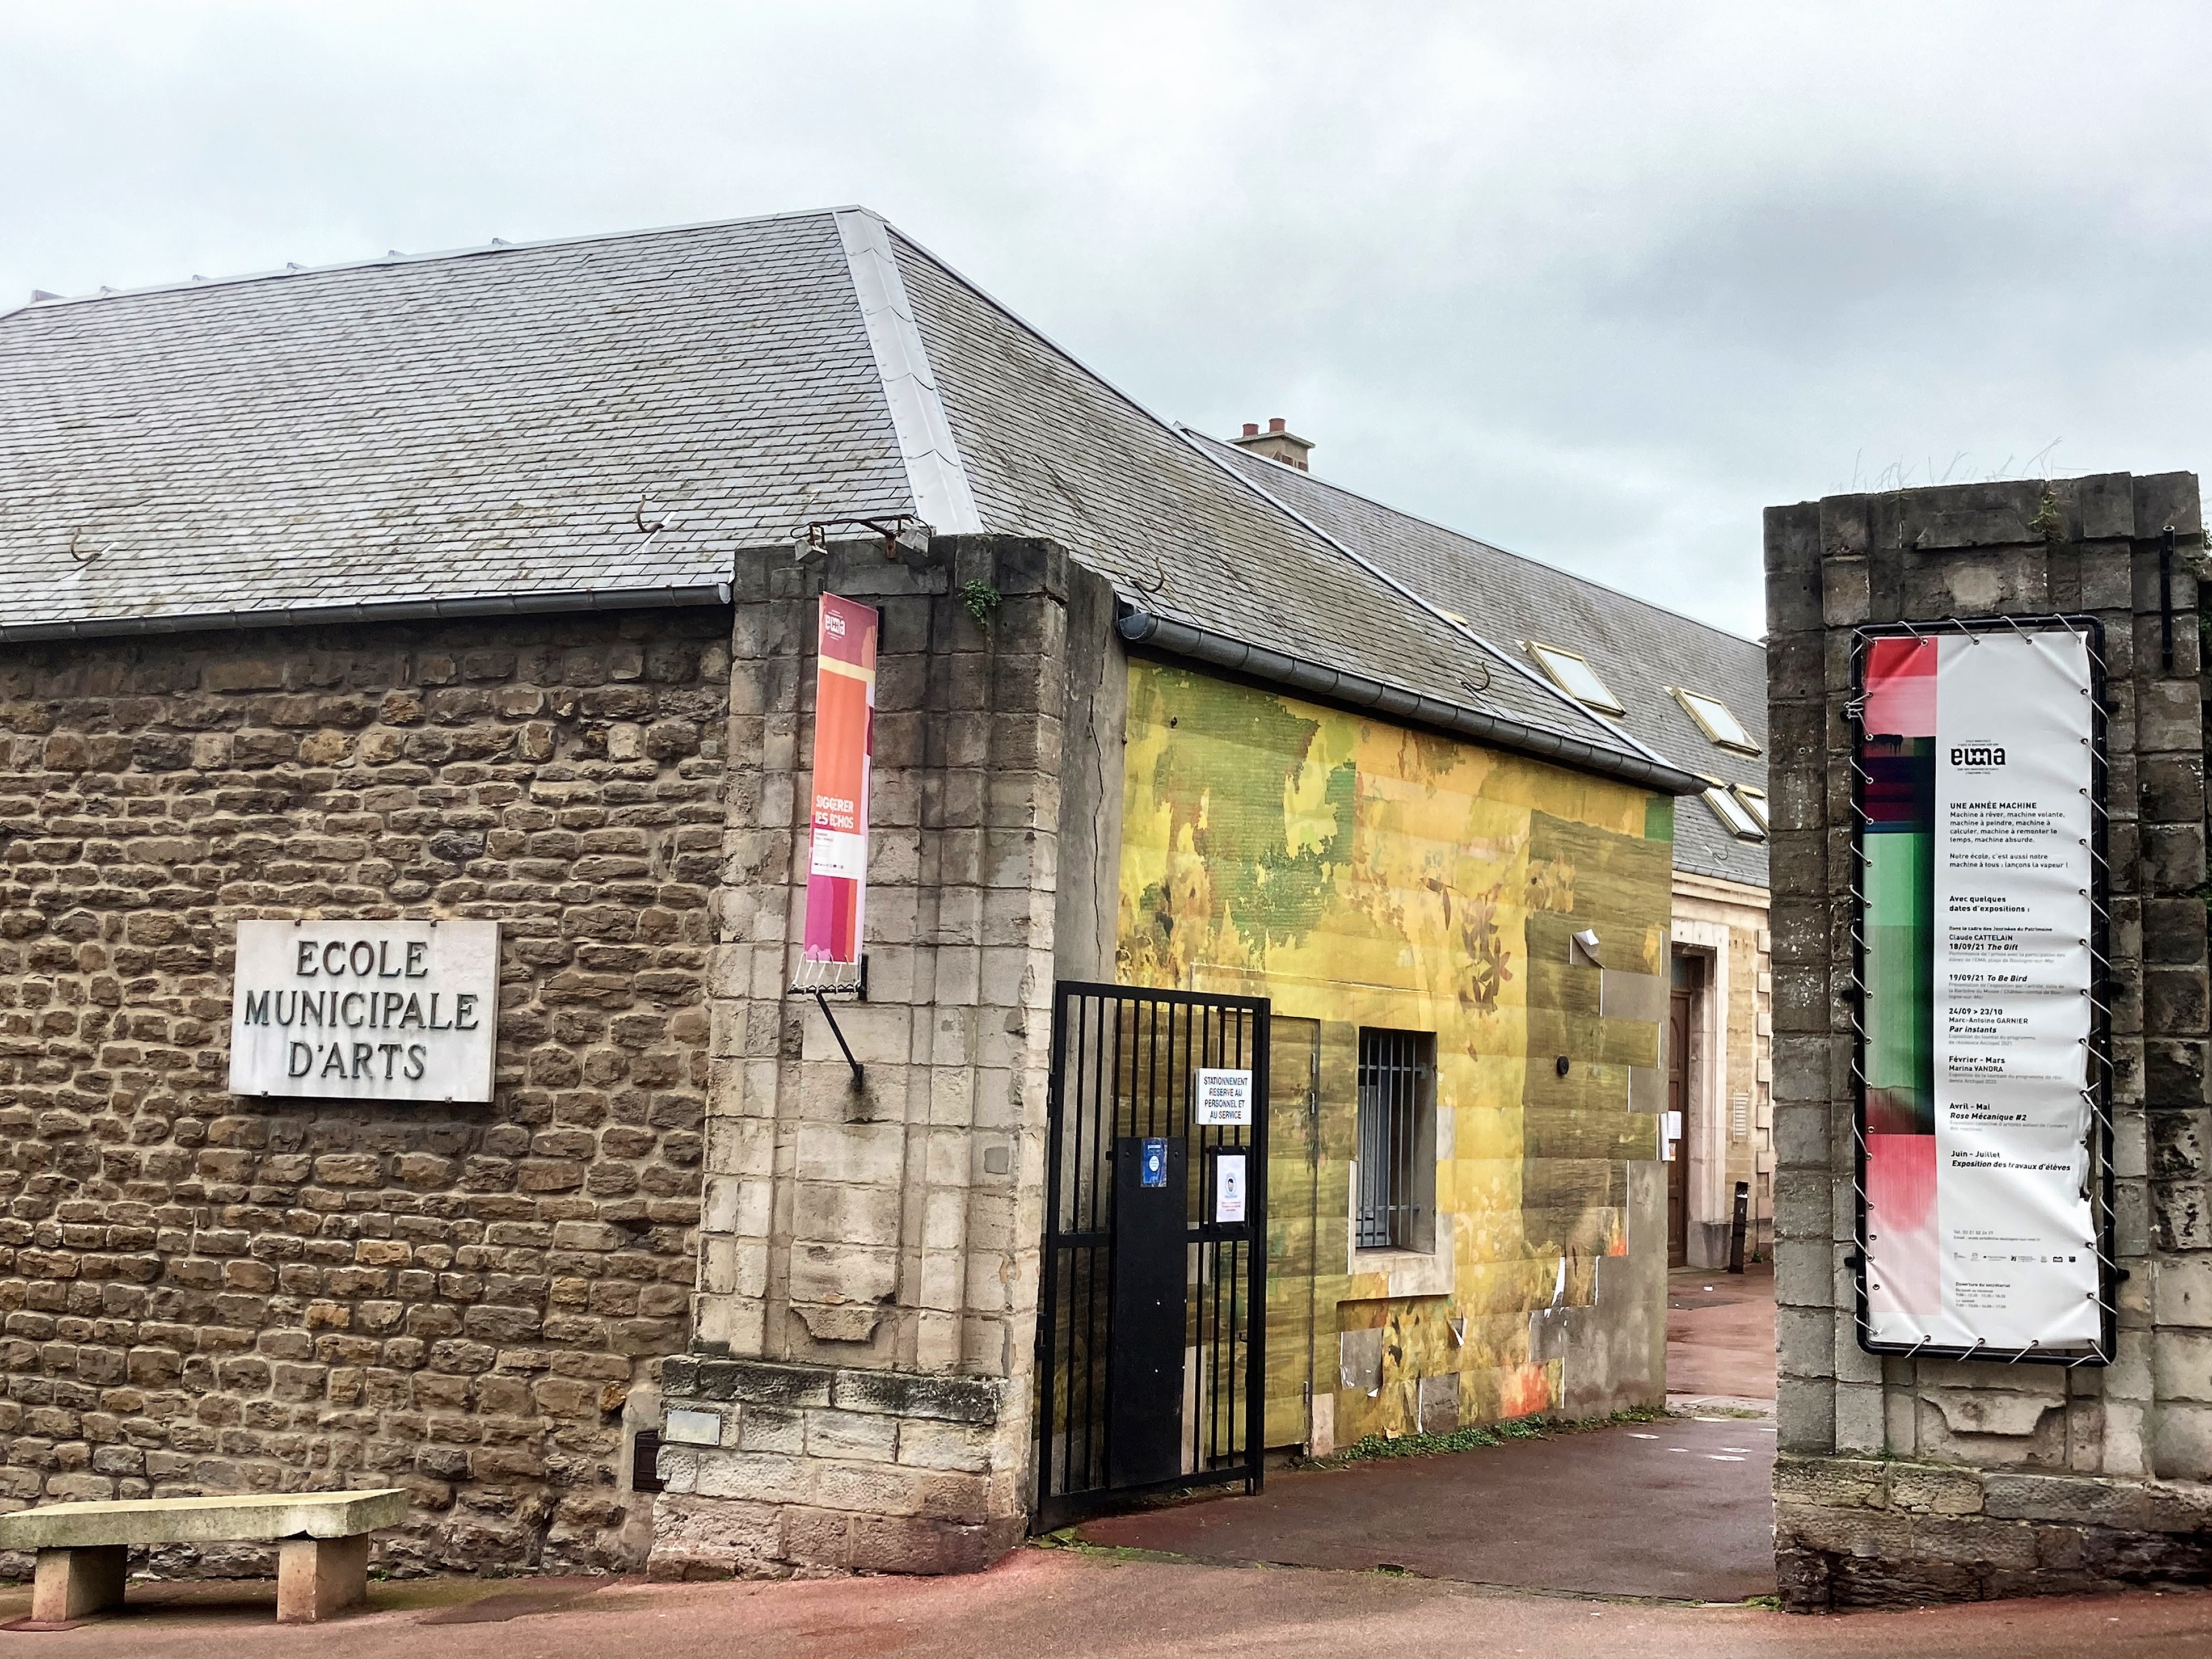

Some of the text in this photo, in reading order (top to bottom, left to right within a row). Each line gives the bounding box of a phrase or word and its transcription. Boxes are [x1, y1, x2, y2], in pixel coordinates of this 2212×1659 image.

[296, 940, 428, 978] ECOLE
[244, 990, 479, 1029] MUNICIPALE
[288, 1041, 427, 1080] D'ARTS
[1204, 1076, 1248, 1085] STATIONNEMENT
[1210, 1088, 1234, 1096] RESERVE
[1204, 1099, 1237, 1108] PERSONNEL
[1971, 1112, 2013, 1122] Mécanique
